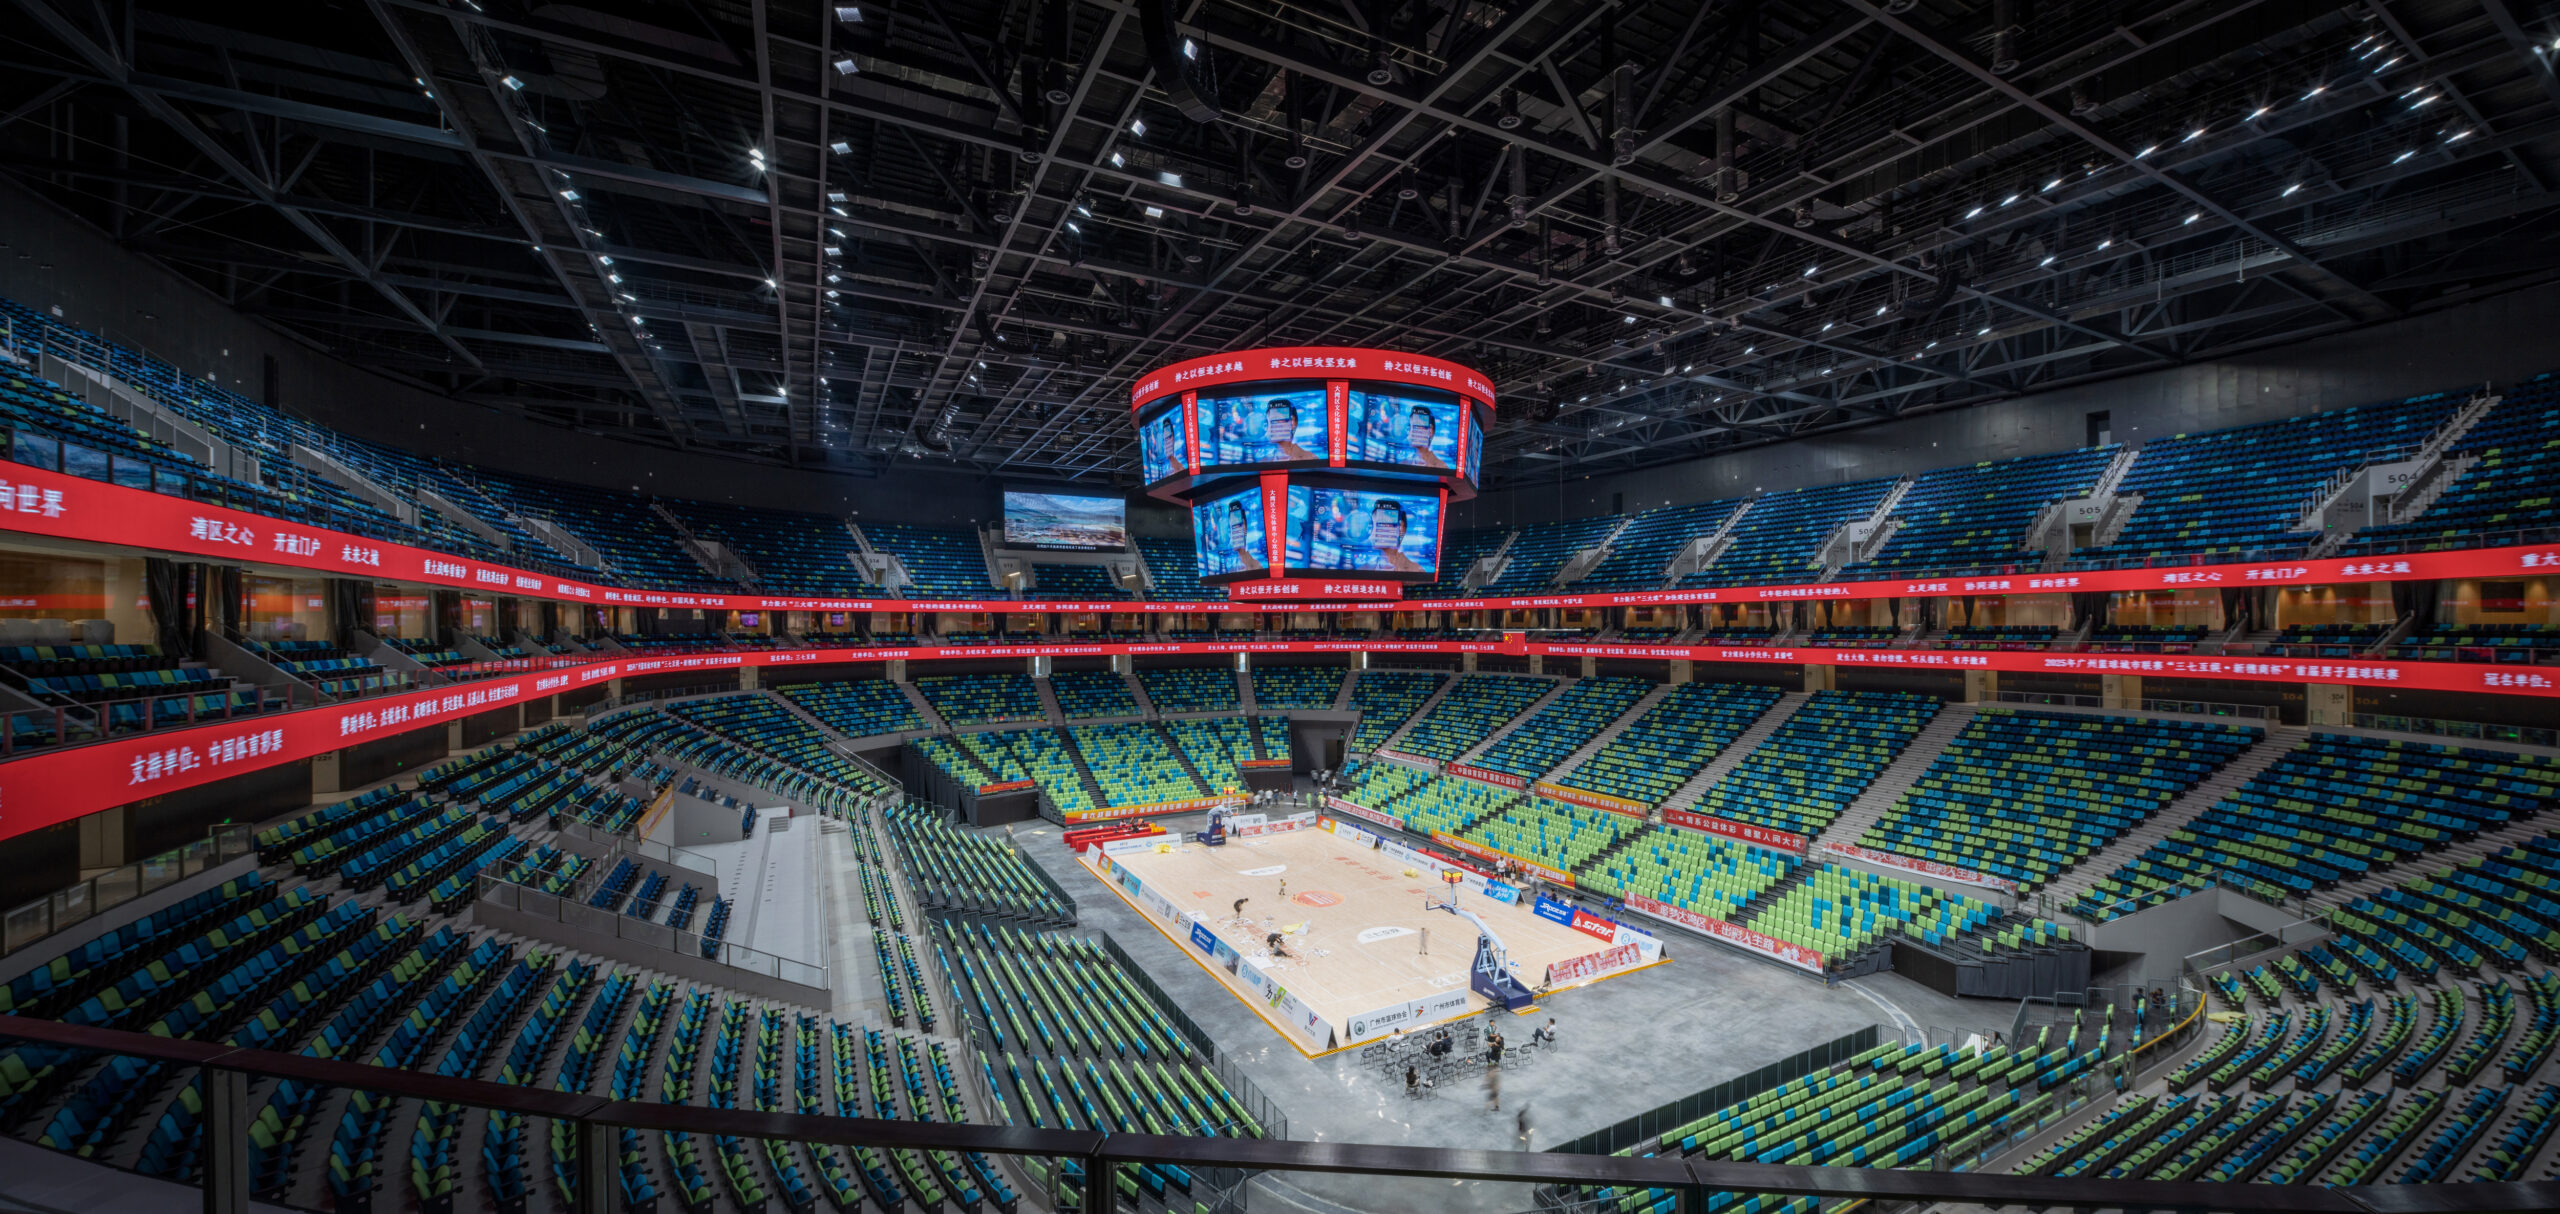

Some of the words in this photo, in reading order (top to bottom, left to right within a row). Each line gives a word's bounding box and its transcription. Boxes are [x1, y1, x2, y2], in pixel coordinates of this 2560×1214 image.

[1175, 361, 1244, 382] 持之以恒追求卓越
[1270, 357, 1357, 369] 持之以恒攻坚克难
[1384, 360, 1453, 381] 持之以恒开拓创新
[2388, 473, 2417, 484] 504
[2079, 506, 2101, 515] 505
[190, 516, 255, 546] 湾区之心
[273, 532, 321, 557] 开放门户
[342, 544, 380, 567] 未来之城
[2162, 571, 2223, 584] 湾区之心
[2245, 567, 2307, 581] 开放门户
[2340, 561, 2412, 575] 未来之城
[1906, 582, 1949, 593] 立足湾区
[2029, 577, 2081, 588] 面向世界
[1660, 904, 1706, 929] 追梦大湾区
[1721, 923, 1774, 952] 出彩人生路
[1433, 997, 1466, 1011] 广州市体育局
[1369, 1010, 1408, 1027] 广州市篮球协会
